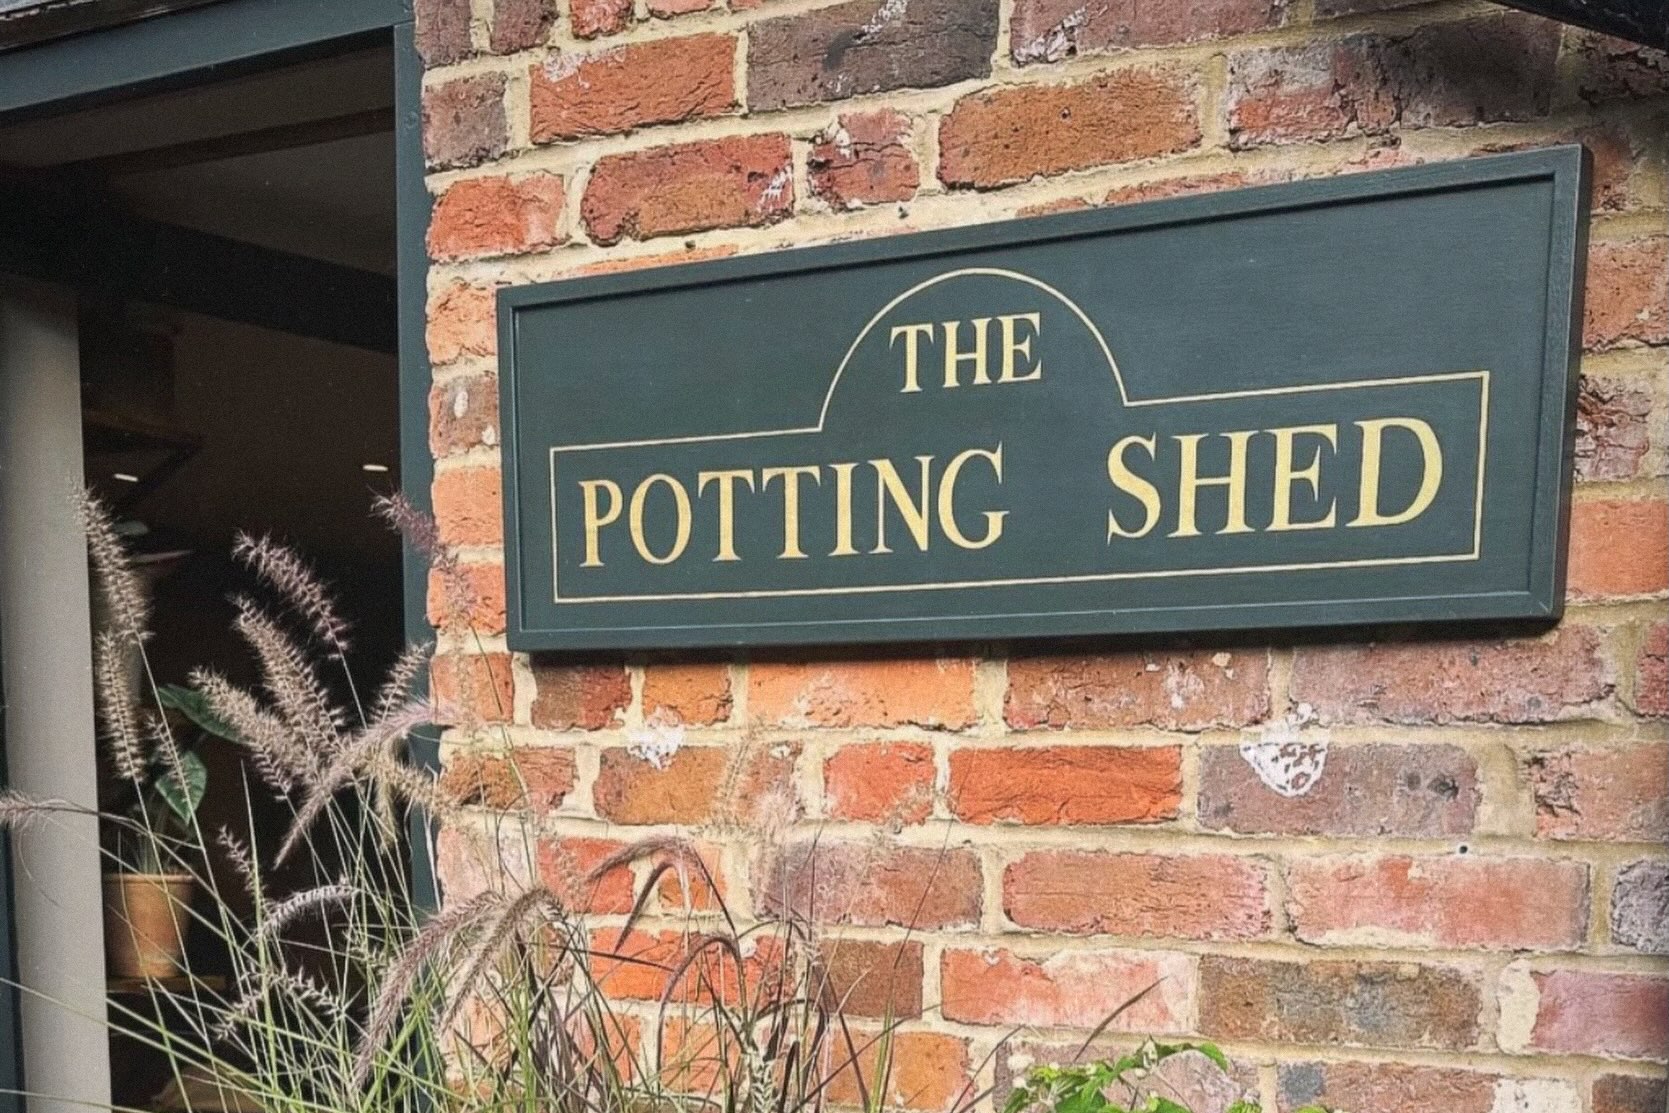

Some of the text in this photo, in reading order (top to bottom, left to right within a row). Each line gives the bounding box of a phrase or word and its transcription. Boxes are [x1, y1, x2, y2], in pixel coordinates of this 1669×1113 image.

[889, 311, 1043, 394] THE
[578, 416, 1444, 568] POTTING SHED
